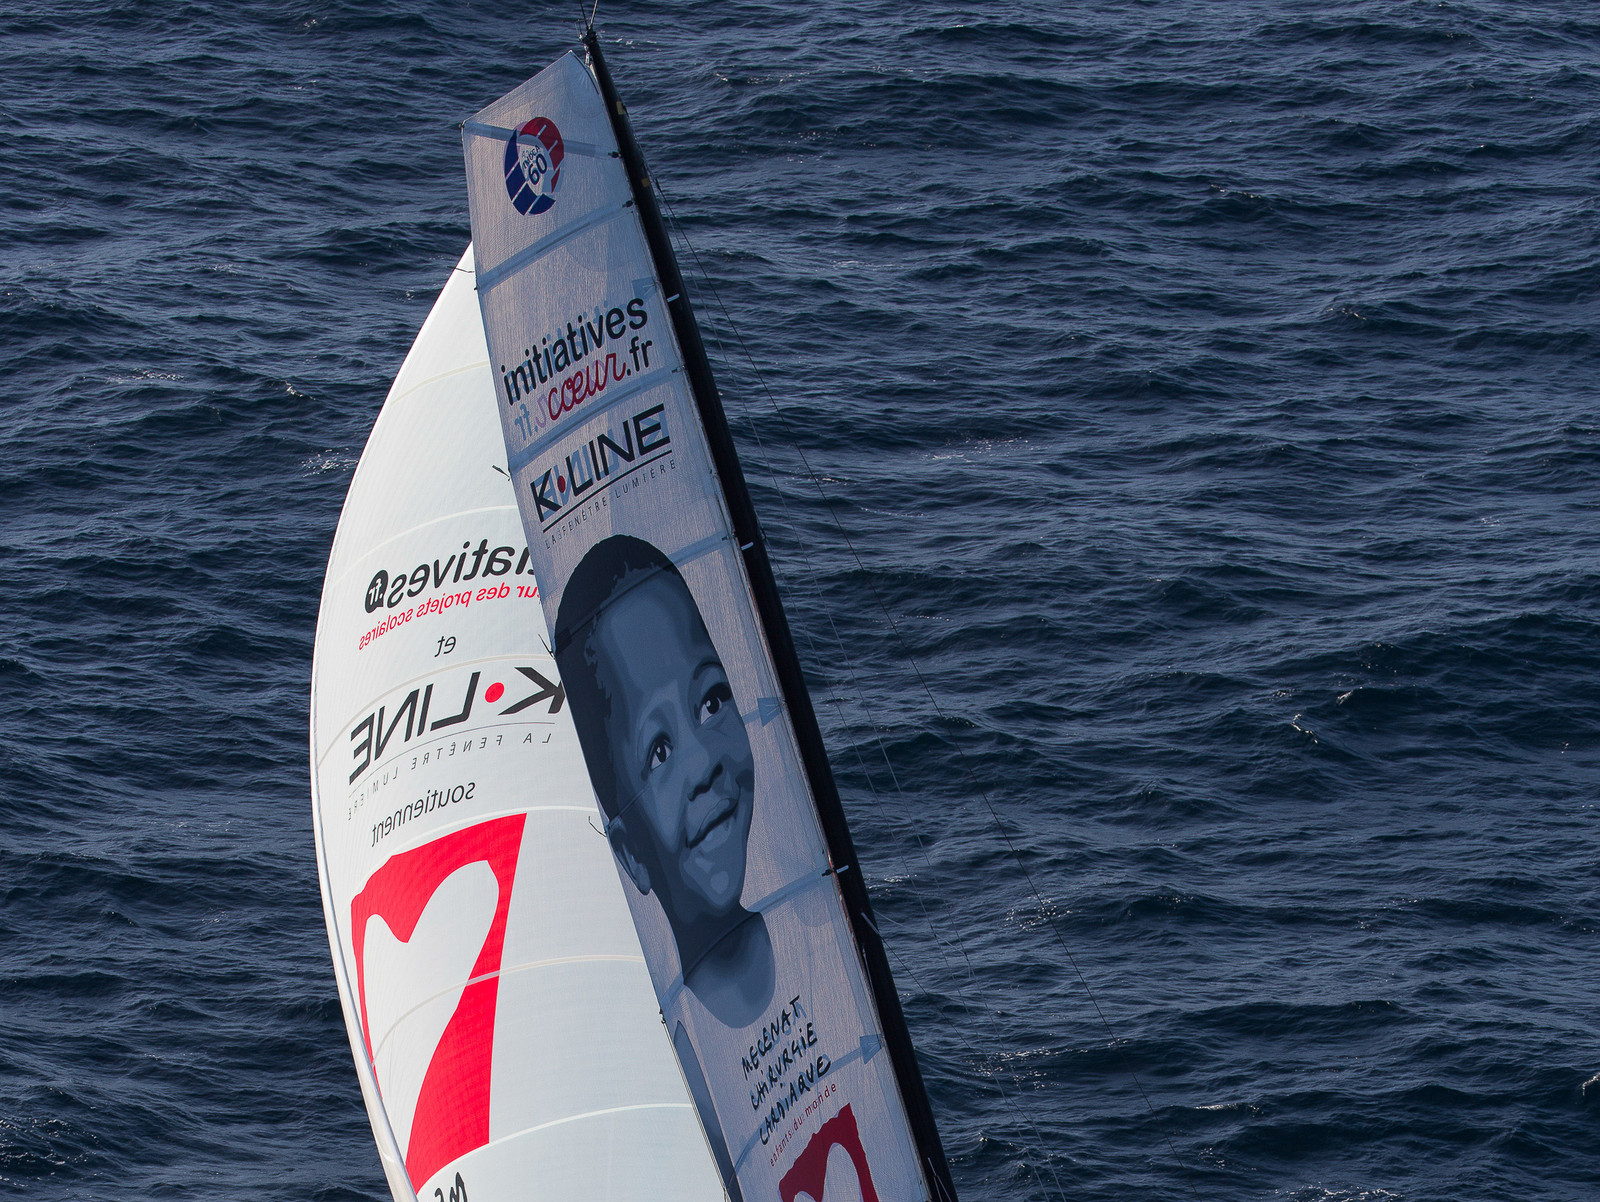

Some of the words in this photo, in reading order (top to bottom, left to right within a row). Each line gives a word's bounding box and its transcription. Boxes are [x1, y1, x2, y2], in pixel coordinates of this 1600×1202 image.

[529, 153, 547, 185] 60
[501, 298, 648, 405] initiatives
[615, 459, 676, 499] LUMIÈRE
[759, 1056, 831, 1145] CARDIAQUE
[769, 1129, 792, 1167] enfants
[793, 1116, 803, 1131] du
[804, 1083, 837, 1117] monde
